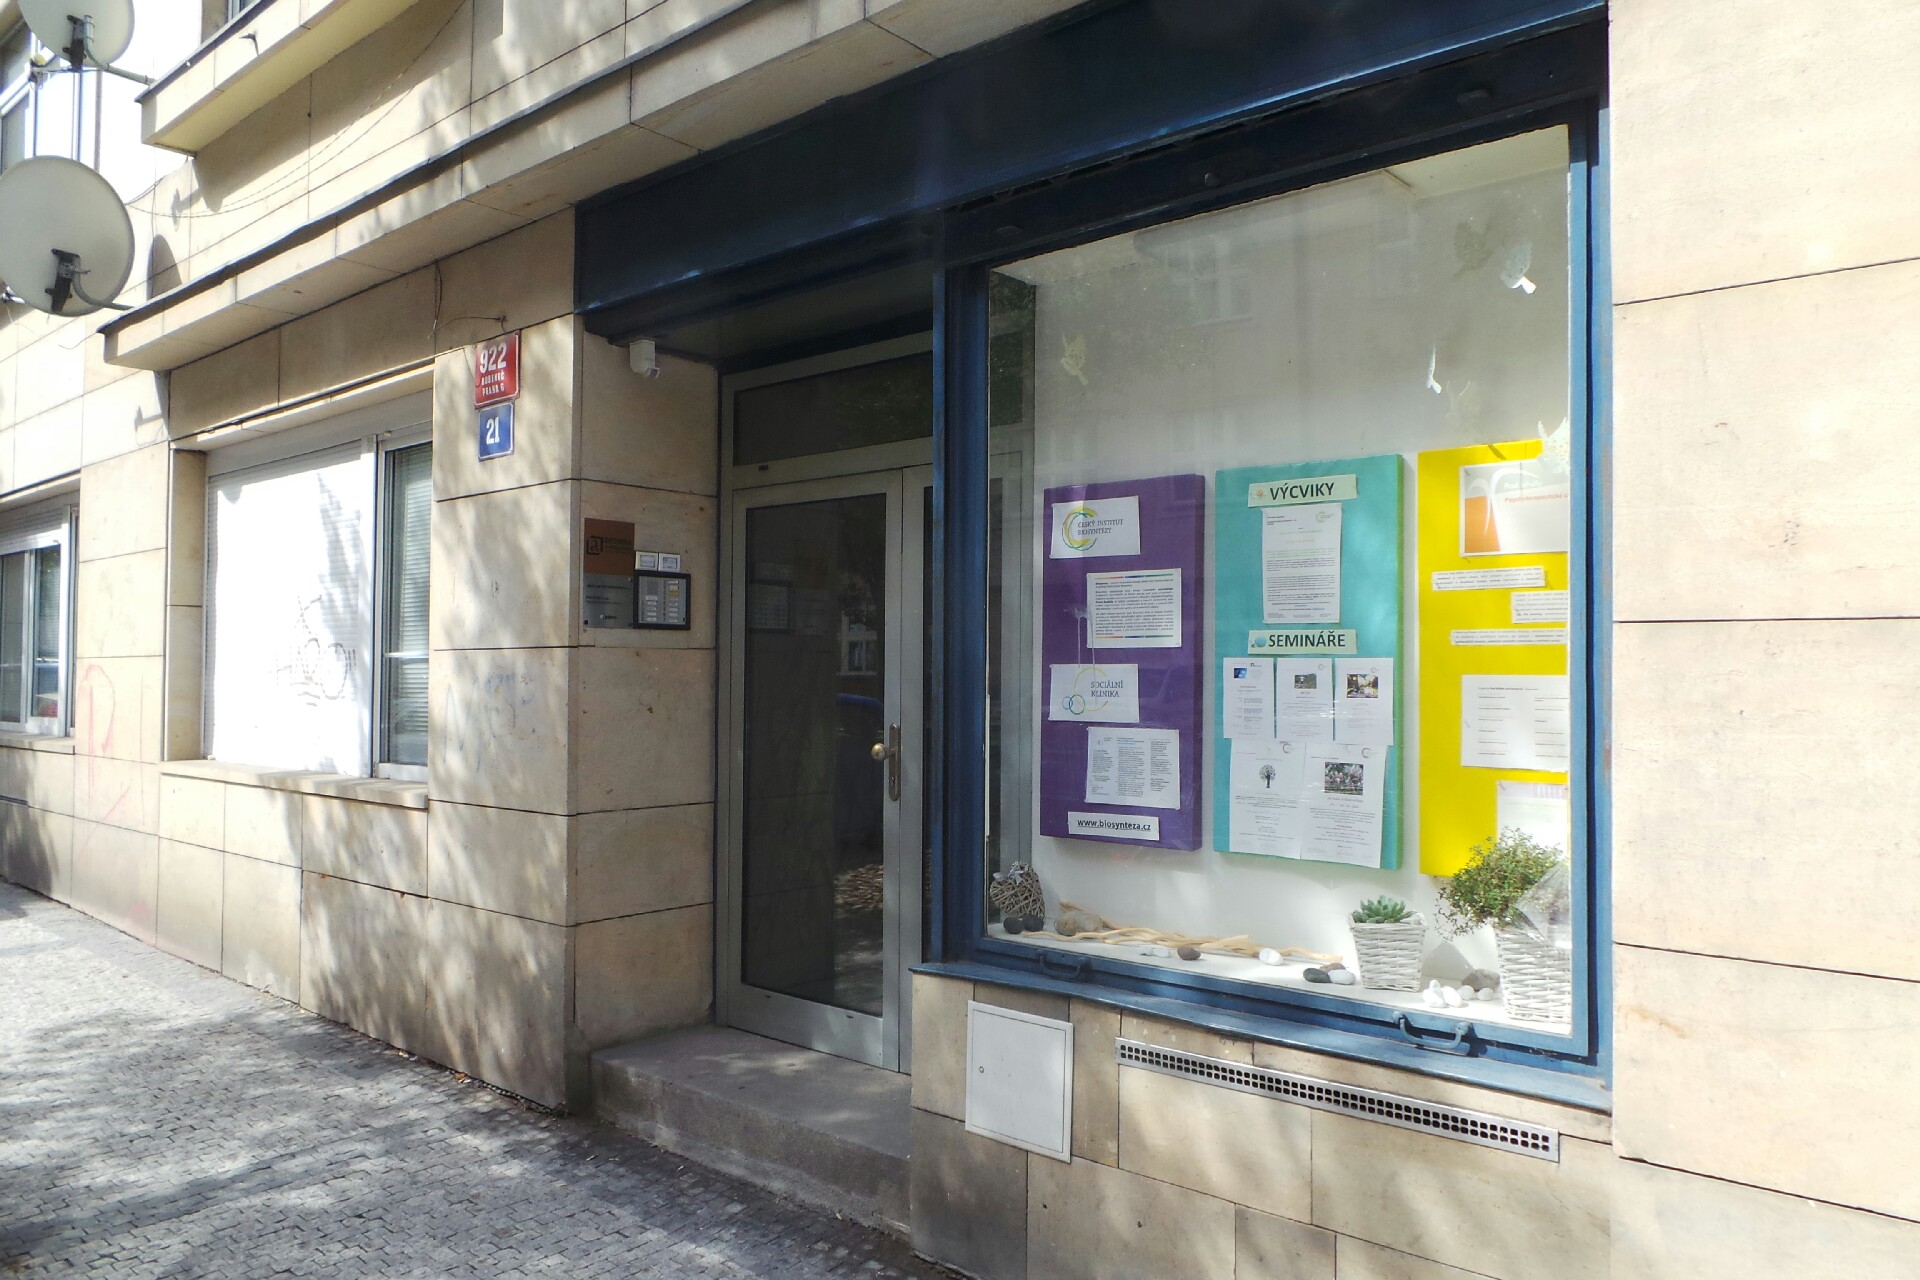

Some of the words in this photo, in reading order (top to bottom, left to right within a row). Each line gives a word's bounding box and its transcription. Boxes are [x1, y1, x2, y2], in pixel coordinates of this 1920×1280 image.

[479, 342, 507, 374] 922
[482, 384, 499, 397] PRAHA
[500, 382, 505, 392] 6
[486, 416, 500, 445] 21
[1270, 482, 1335, 501] VÝCVIKY
[1077, 519, 1096, 528] ČESKÝ
[1097, 518, 1124, 526] INSTITUT
[1268, 630, 1346, 648] SEMINÁŘE
[1090, 679, 1124, 689] SOCIÁLNÍ
[1091, 690, 1120, 698] KLINIKA
[1077, 819, 1152, 832] www.biosynteza.cz
